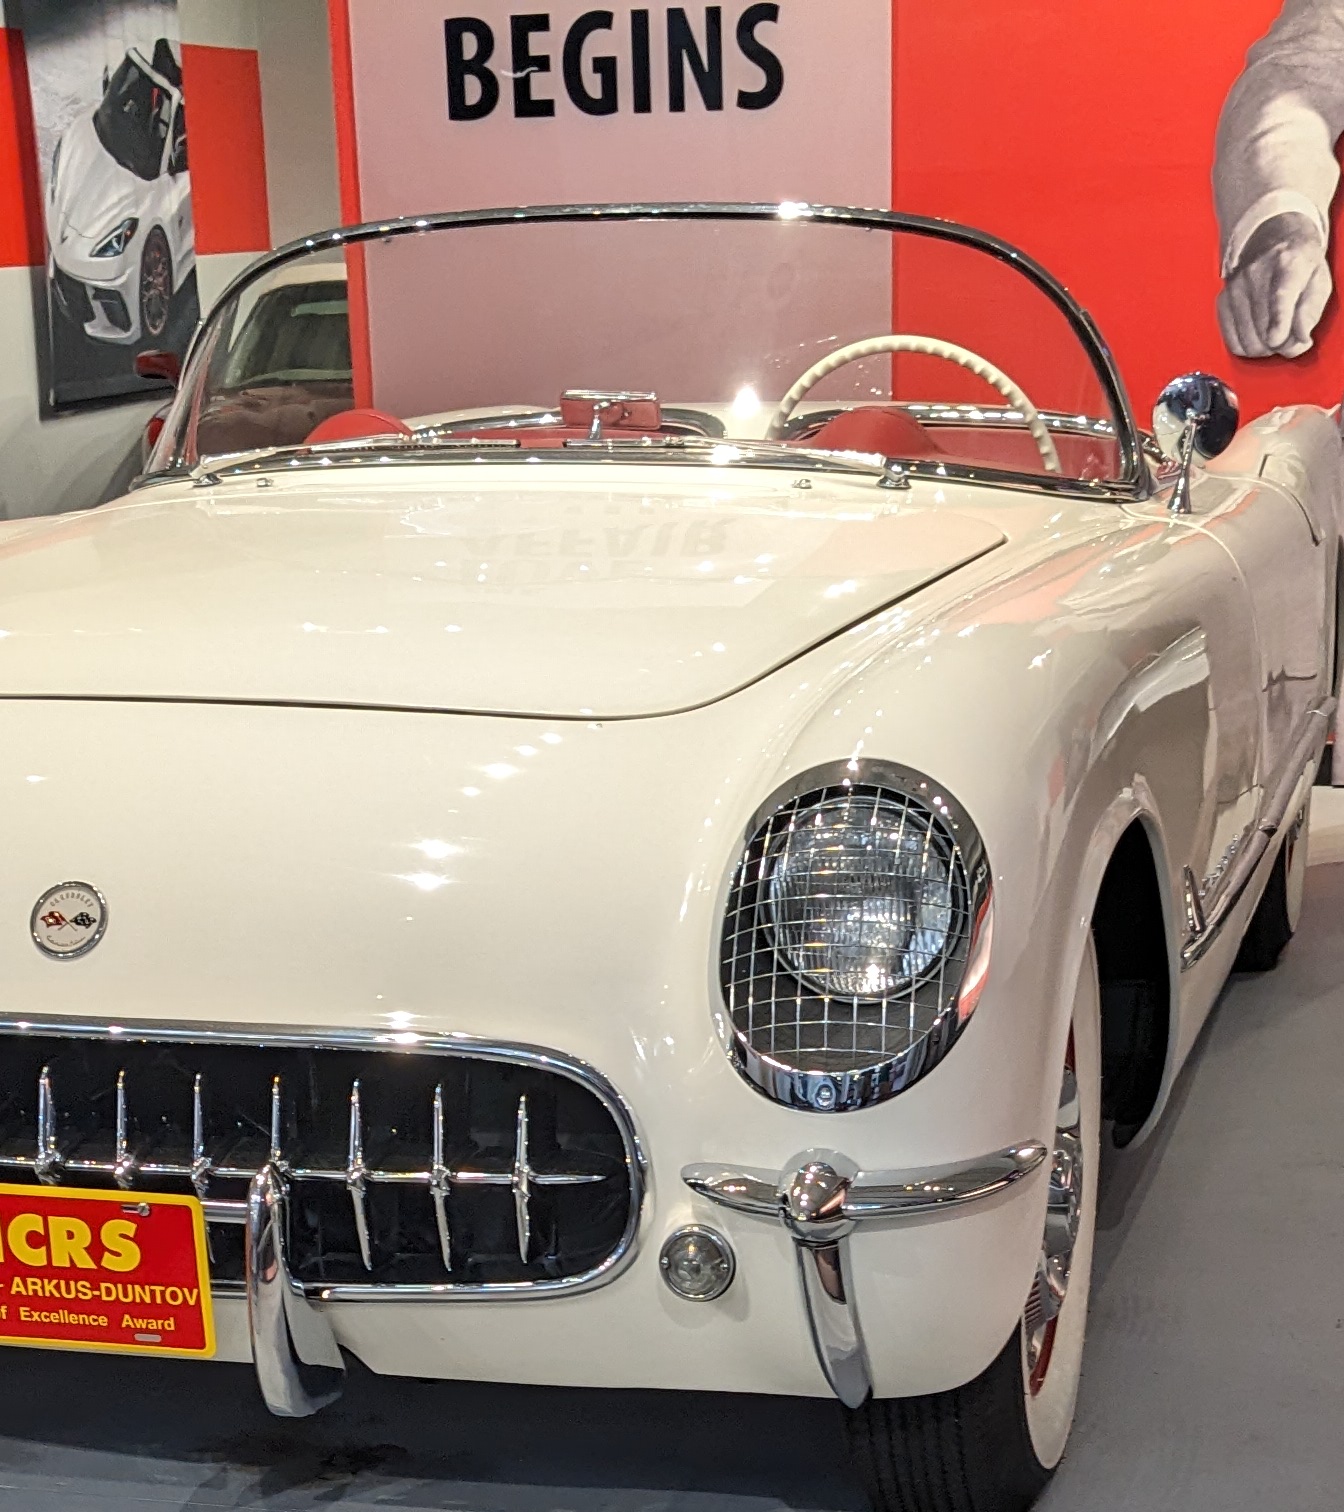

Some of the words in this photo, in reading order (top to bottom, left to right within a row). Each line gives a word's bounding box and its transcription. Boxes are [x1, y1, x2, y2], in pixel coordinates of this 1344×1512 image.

[444, 2, 785, 121] BEGINS
[9, 1276, 199, 1307] ARKUS-DUNTOV
[19, 1307, 109, 1328] Excellence
[121, 1313, 176, 1332] Award
